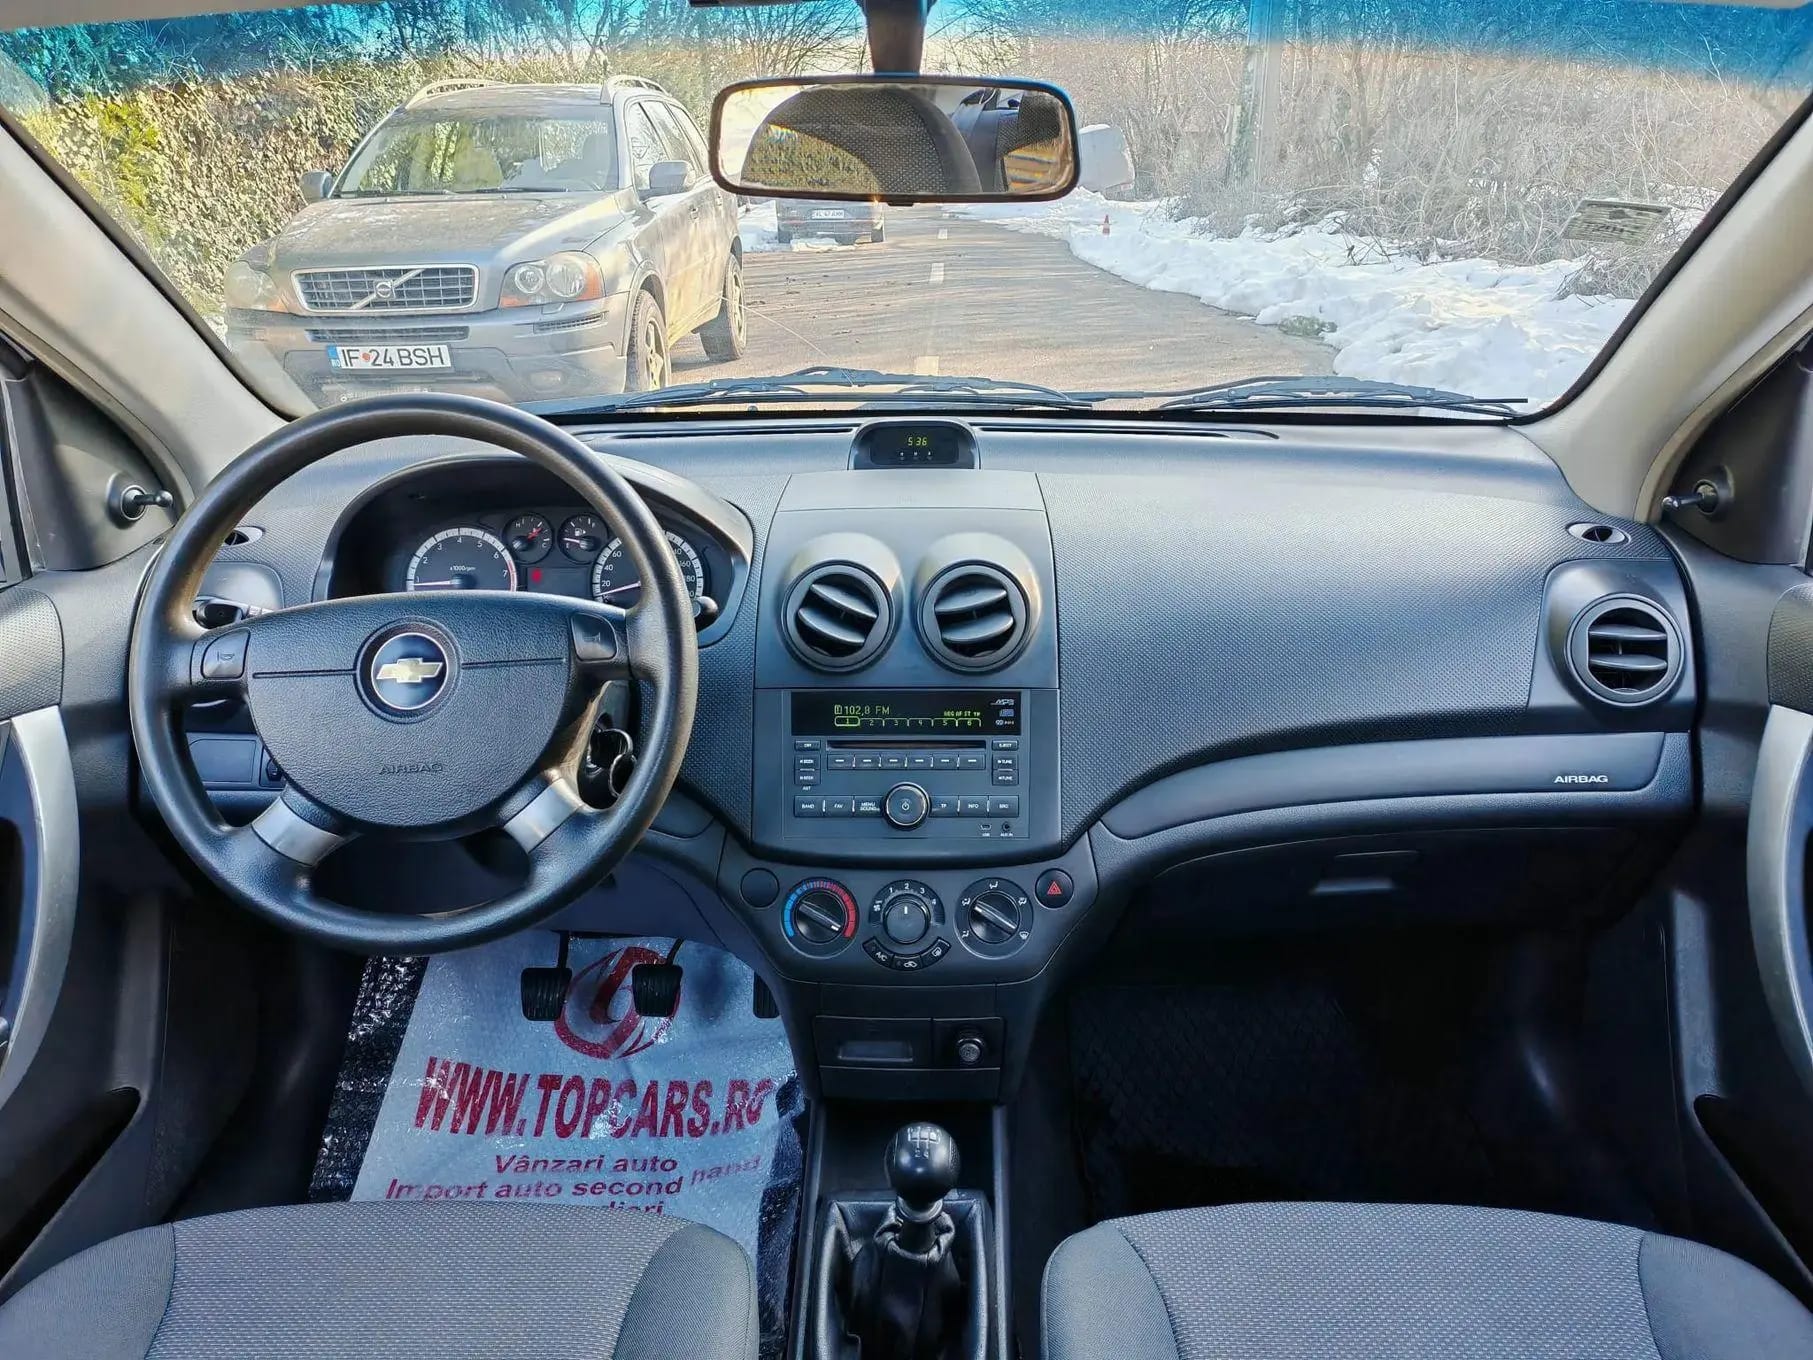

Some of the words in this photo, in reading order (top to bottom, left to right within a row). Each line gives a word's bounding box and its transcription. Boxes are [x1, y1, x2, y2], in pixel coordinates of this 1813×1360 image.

[341, 348, 360, 367] IF
[369, 348, 395, 367] 24
[397, 346, 446, 367] BSH
[612, 550, 622, 558] 60
[604, 563, 614, 571] 40
[875, 705, 890, 715] FM
[379, 762, 443, 775] AIRBAG
[1553, 774, 1609, 784] AIRBAG
[495, 1154, 605, 1174] Vânzari
[612, 1154, 679, 1173] auto
[494, 1180, 562, 1199] auto
[571, 1176, 684, 1197] second
